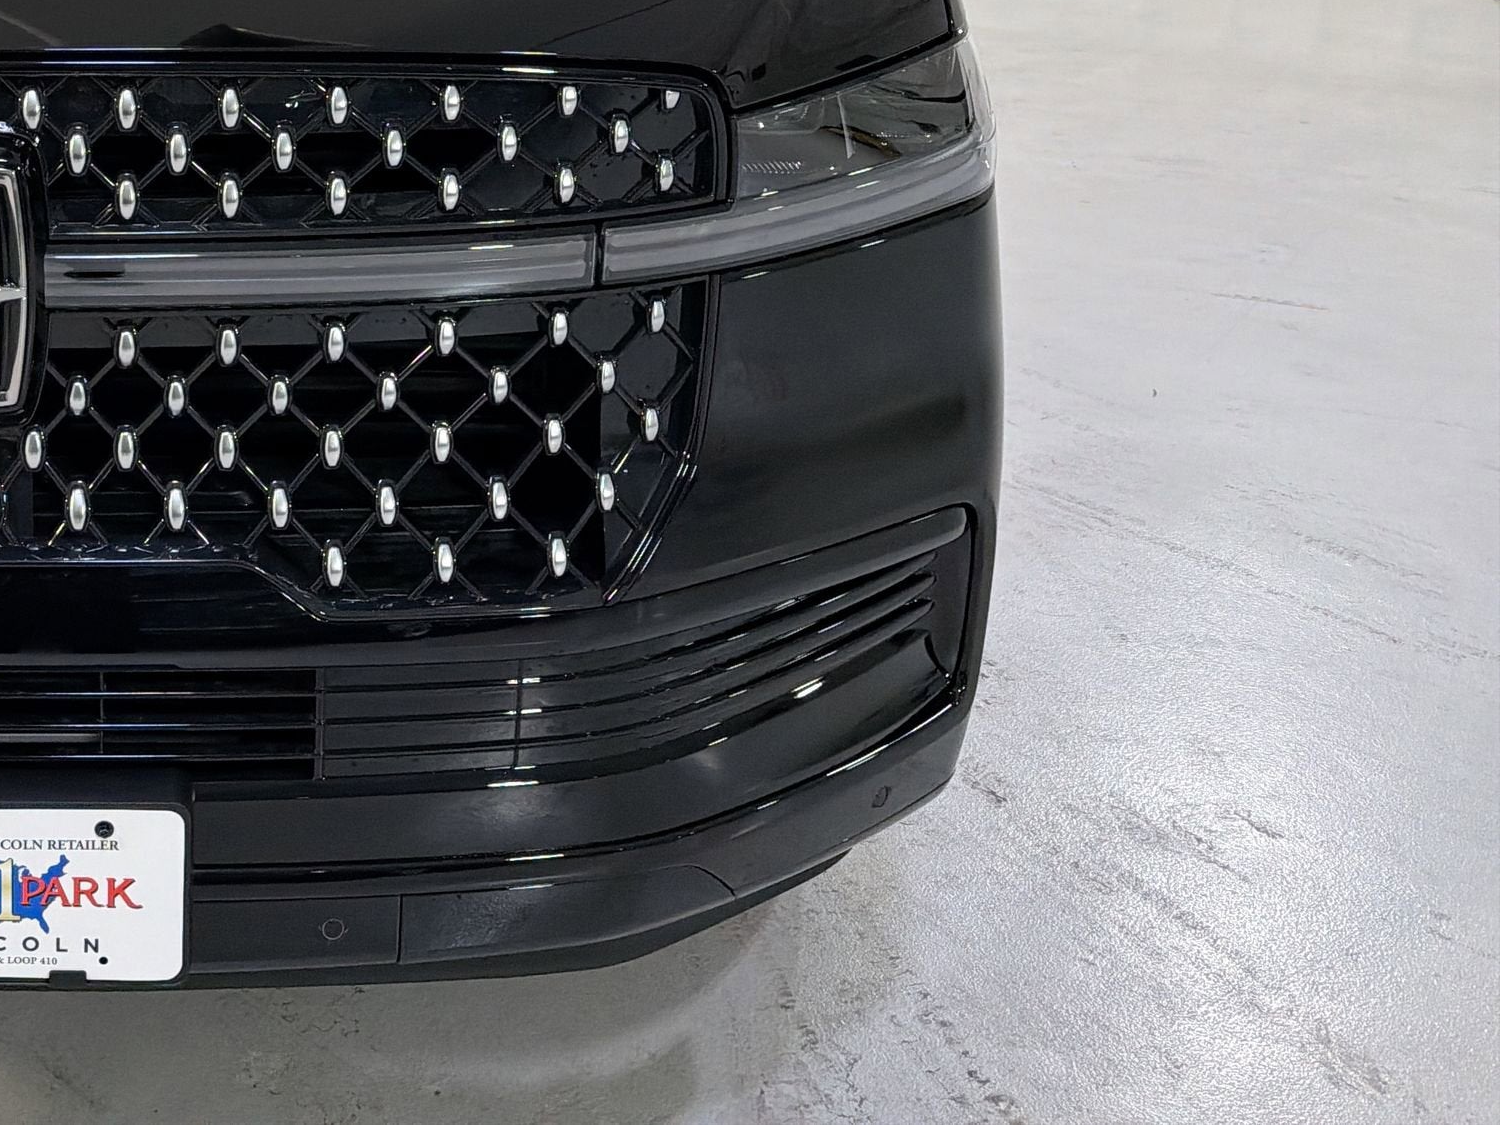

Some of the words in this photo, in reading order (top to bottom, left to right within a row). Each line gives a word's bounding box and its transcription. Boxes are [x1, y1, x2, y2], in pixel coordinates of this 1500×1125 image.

[47, 839, 119, 851] RETAILER
[20, 876, 143, 909] PARK
[7, 956, 38, 965] LOOP
[40, 956, 58, 965] 410
